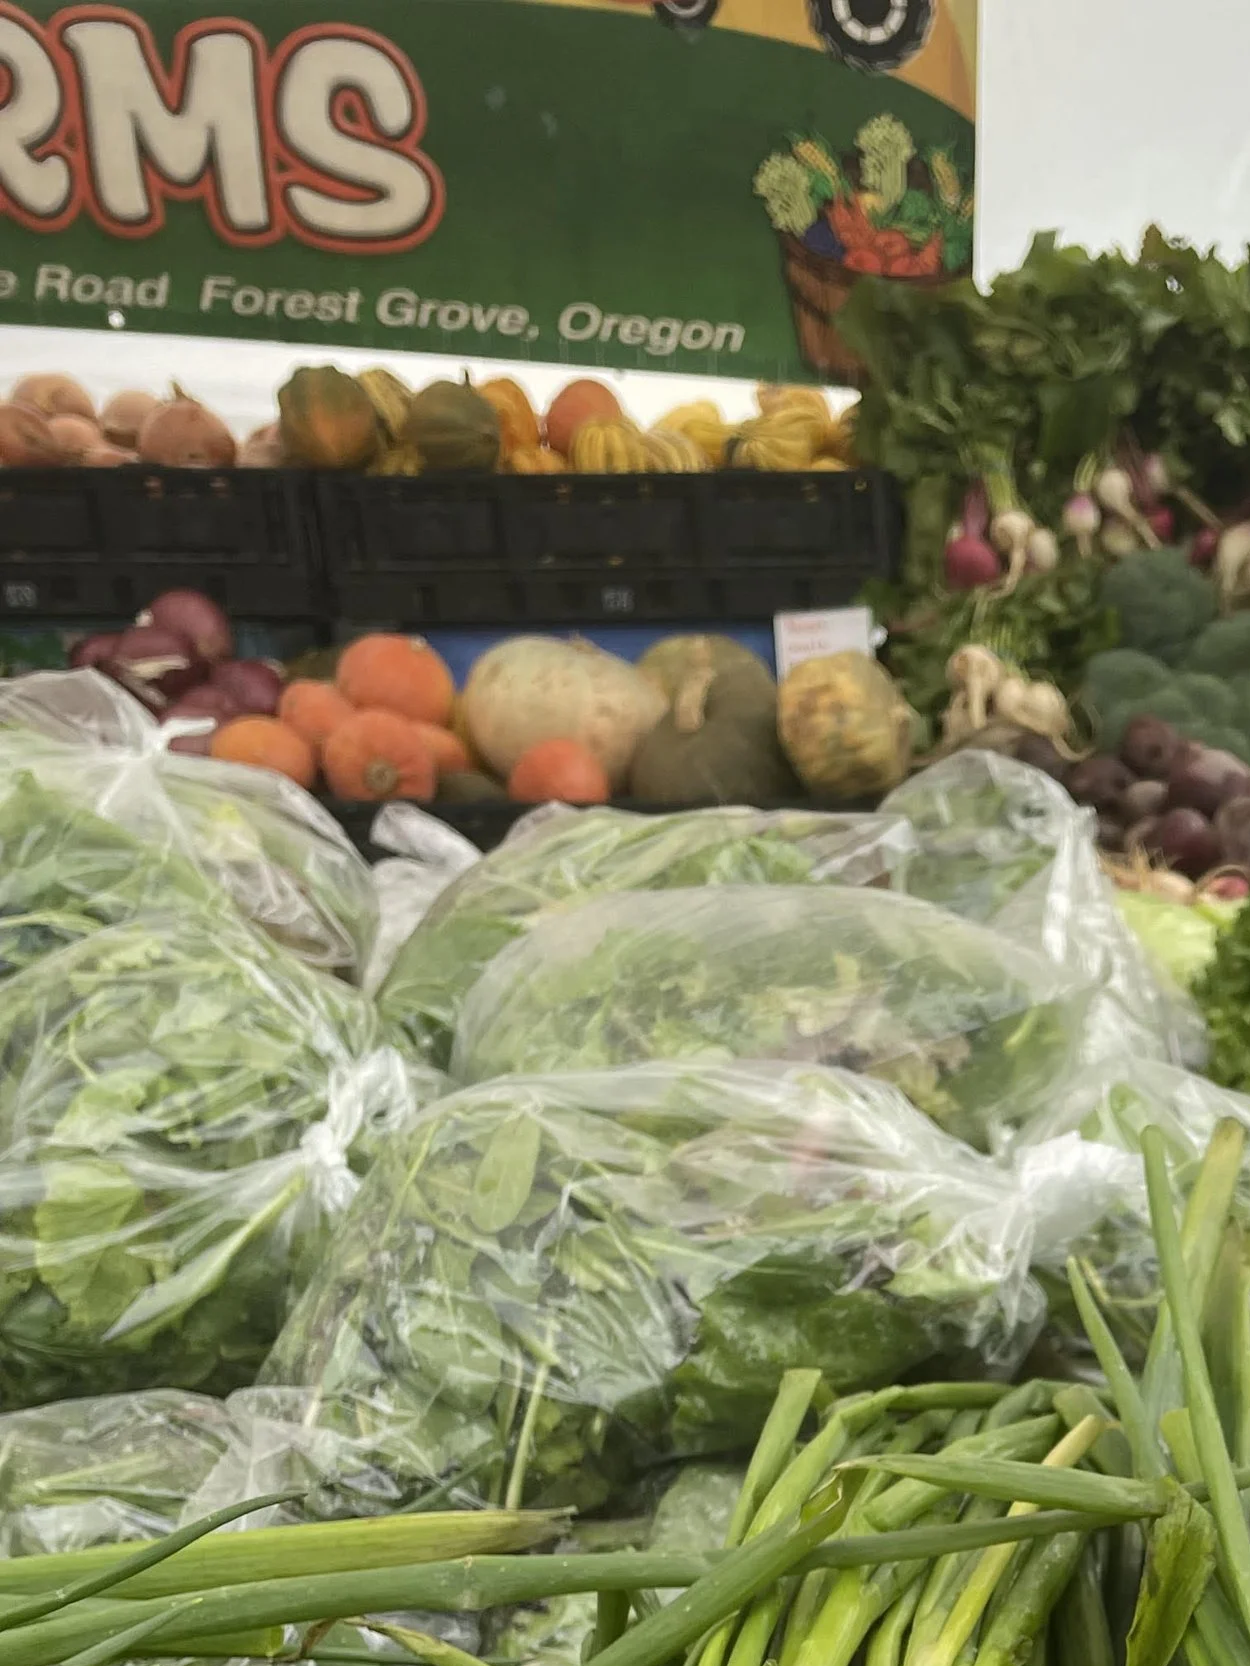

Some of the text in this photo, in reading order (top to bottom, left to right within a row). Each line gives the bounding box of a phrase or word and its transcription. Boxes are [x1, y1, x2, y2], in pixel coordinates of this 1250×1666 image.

[36, 264, 170, 308] Road
[200, 275, 361, 324] Forest
[375, 287, 540, 342] Grove,
[558, 302, 746, 357] Oregon
